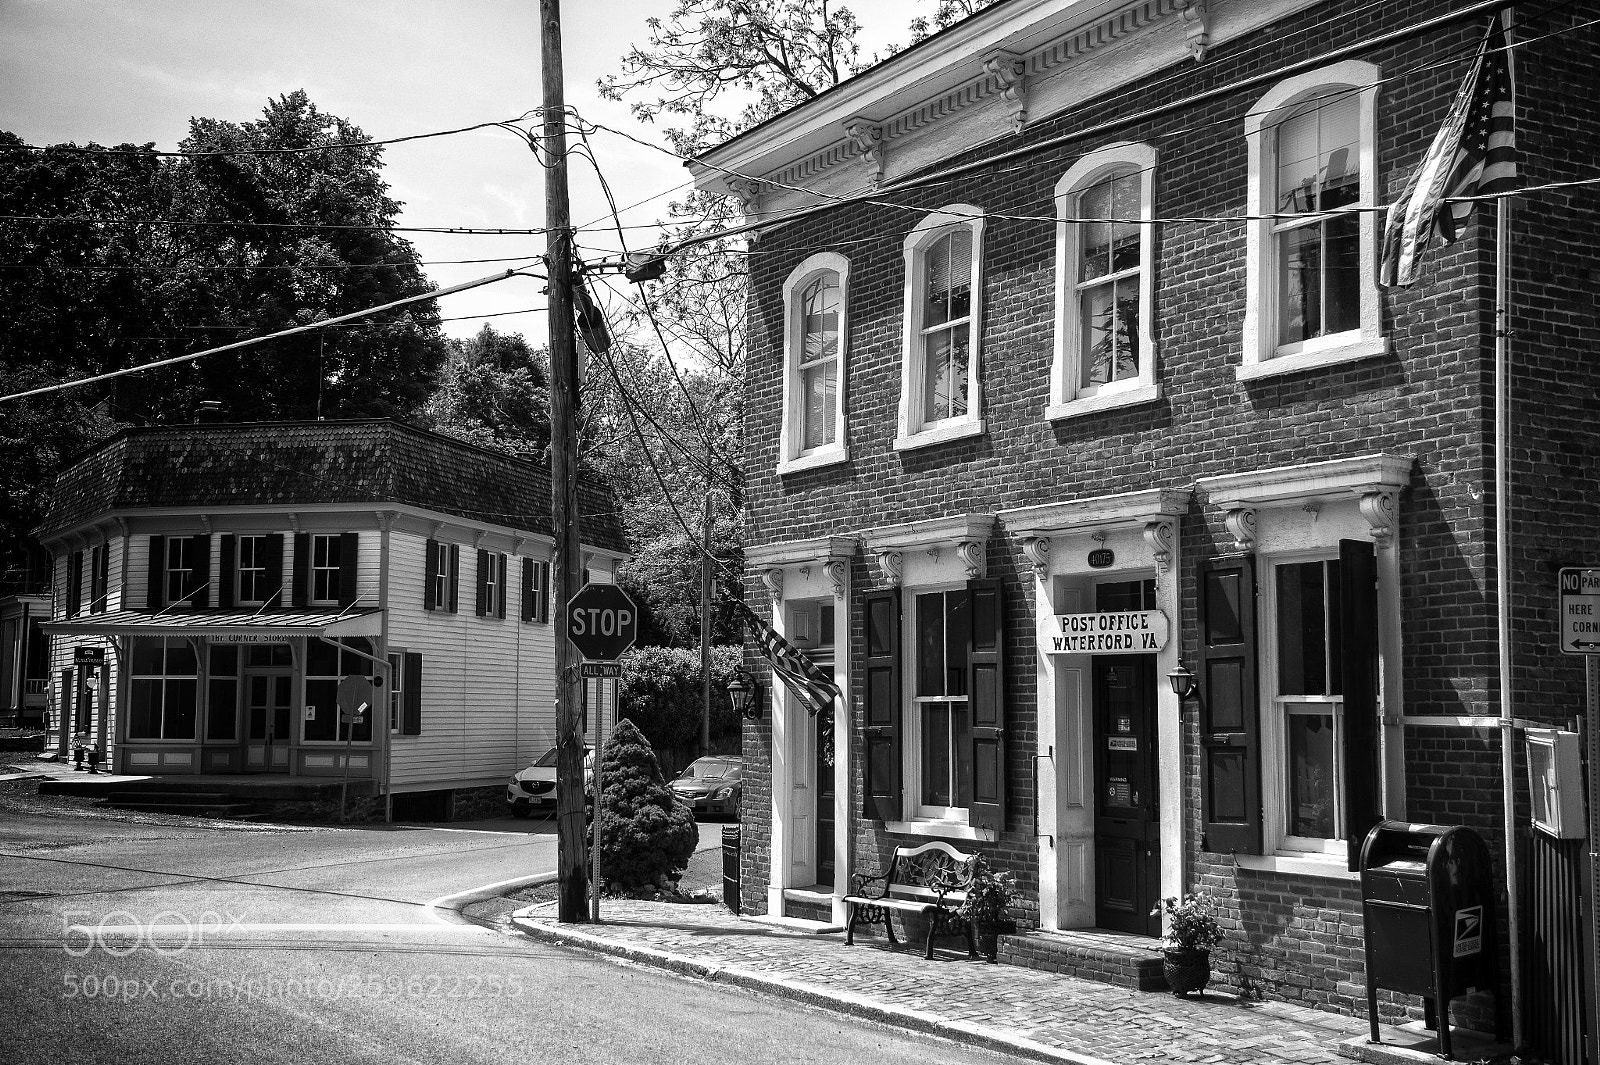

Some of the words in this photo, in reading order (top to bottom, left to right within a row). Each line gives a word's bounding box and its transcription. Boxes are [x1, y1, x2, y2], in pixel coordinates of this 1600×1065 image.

[1090, 552, 1110, 565] 40175
[1562, 574, 1579, 590] NO
[1568, 603, 1593, 615] HERE
[572, 607, 632, 637] STOP
[1062, 616, 1096, 632] POST
[1099, 613, 1149, 631] OFFICE
[1572, 621, 1600, 633] CORN
[228, 633, 258, 642] CORNER
[583, 665, 599, 676] ALL
[603, 665, 619, 676] WAY
